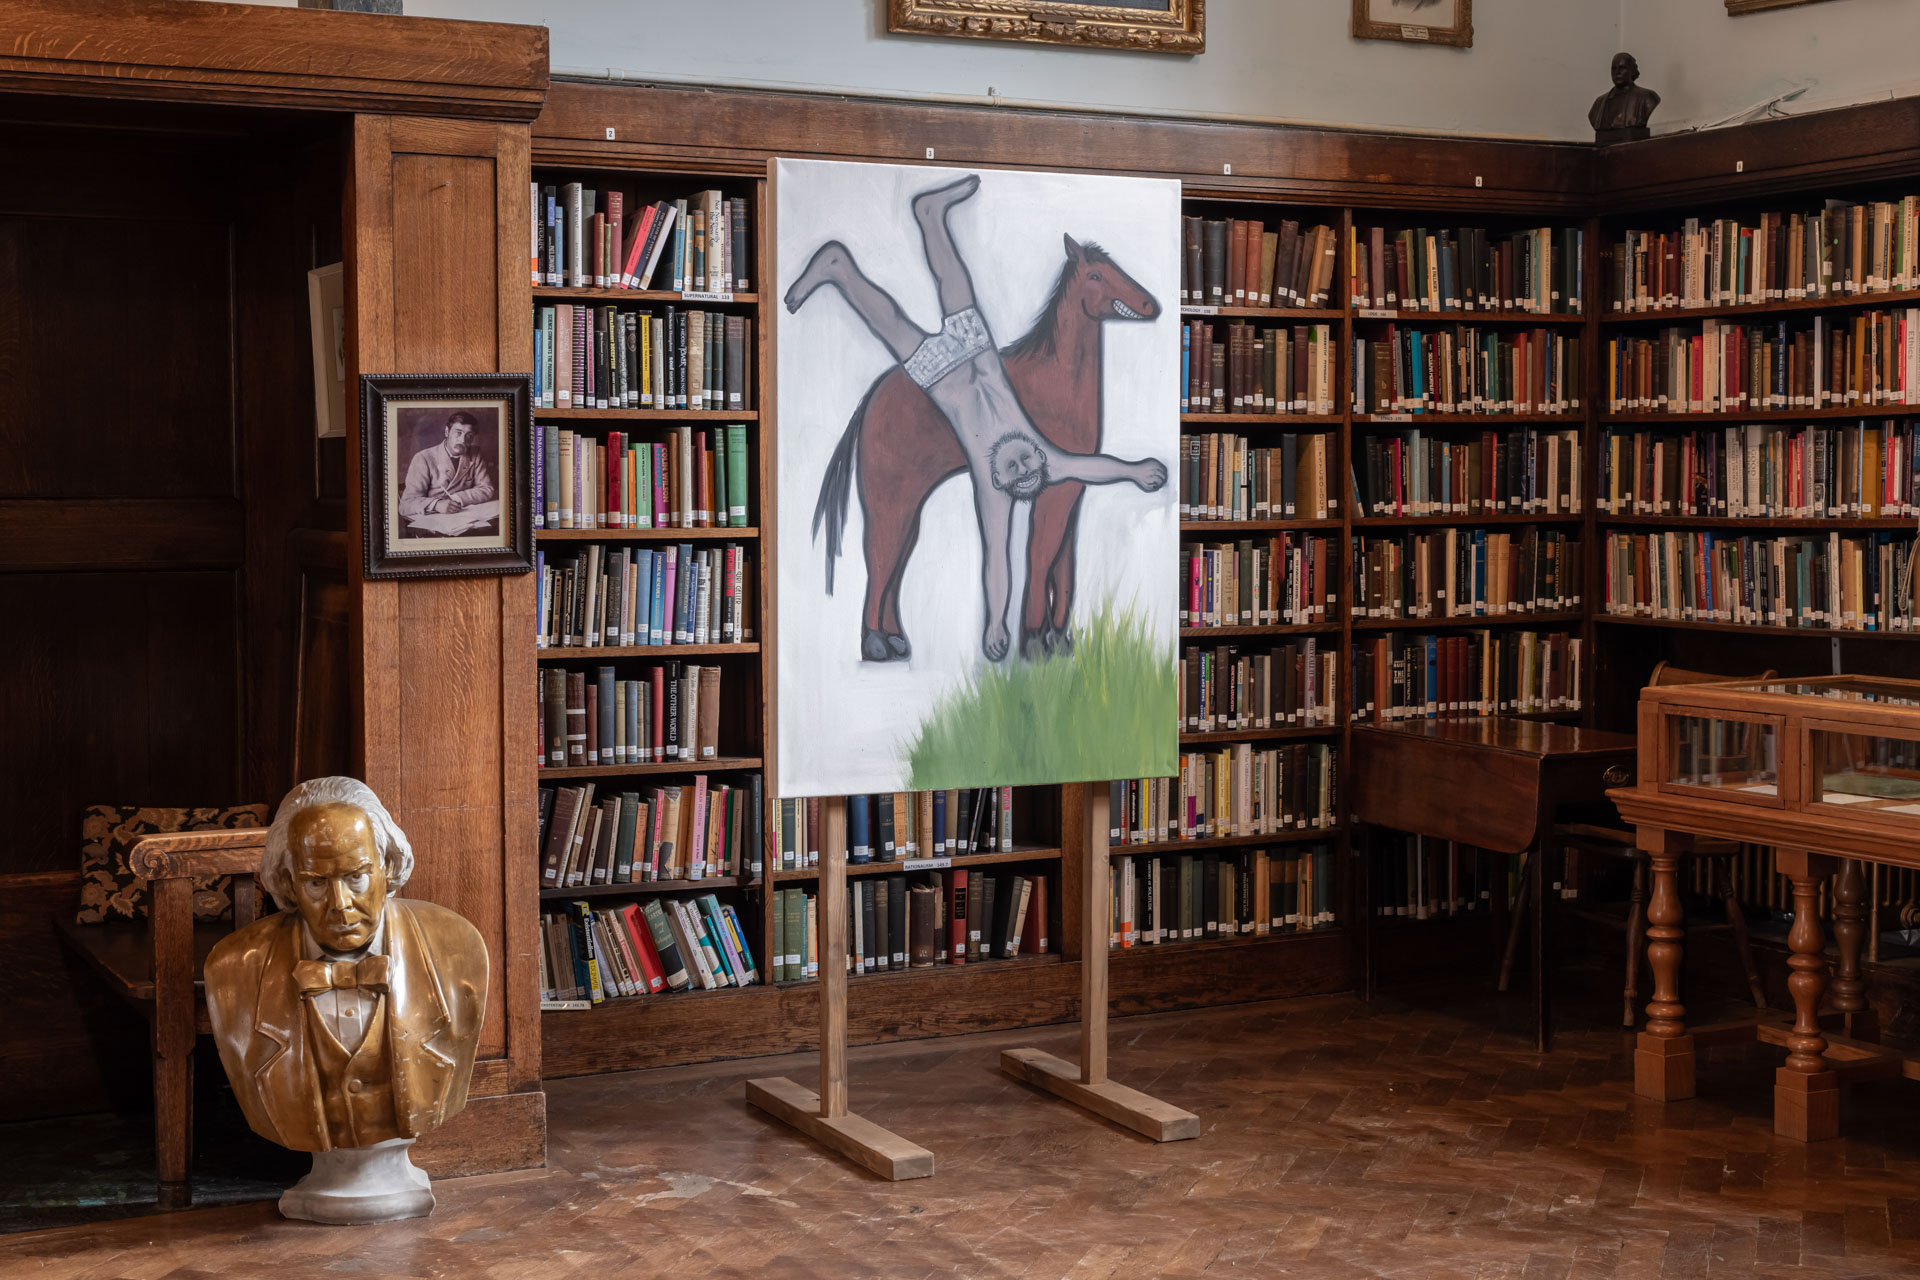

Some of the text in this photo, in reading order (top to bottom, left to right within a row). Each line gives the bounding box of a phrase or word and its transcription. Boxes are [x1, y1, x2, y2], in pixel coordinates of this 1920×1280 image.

[727, 548, 736, 572] PSYCHIC
[669, 680, 678, 742] THE OTHER WORLD
[584, 918, 594, 960] Existentialism
